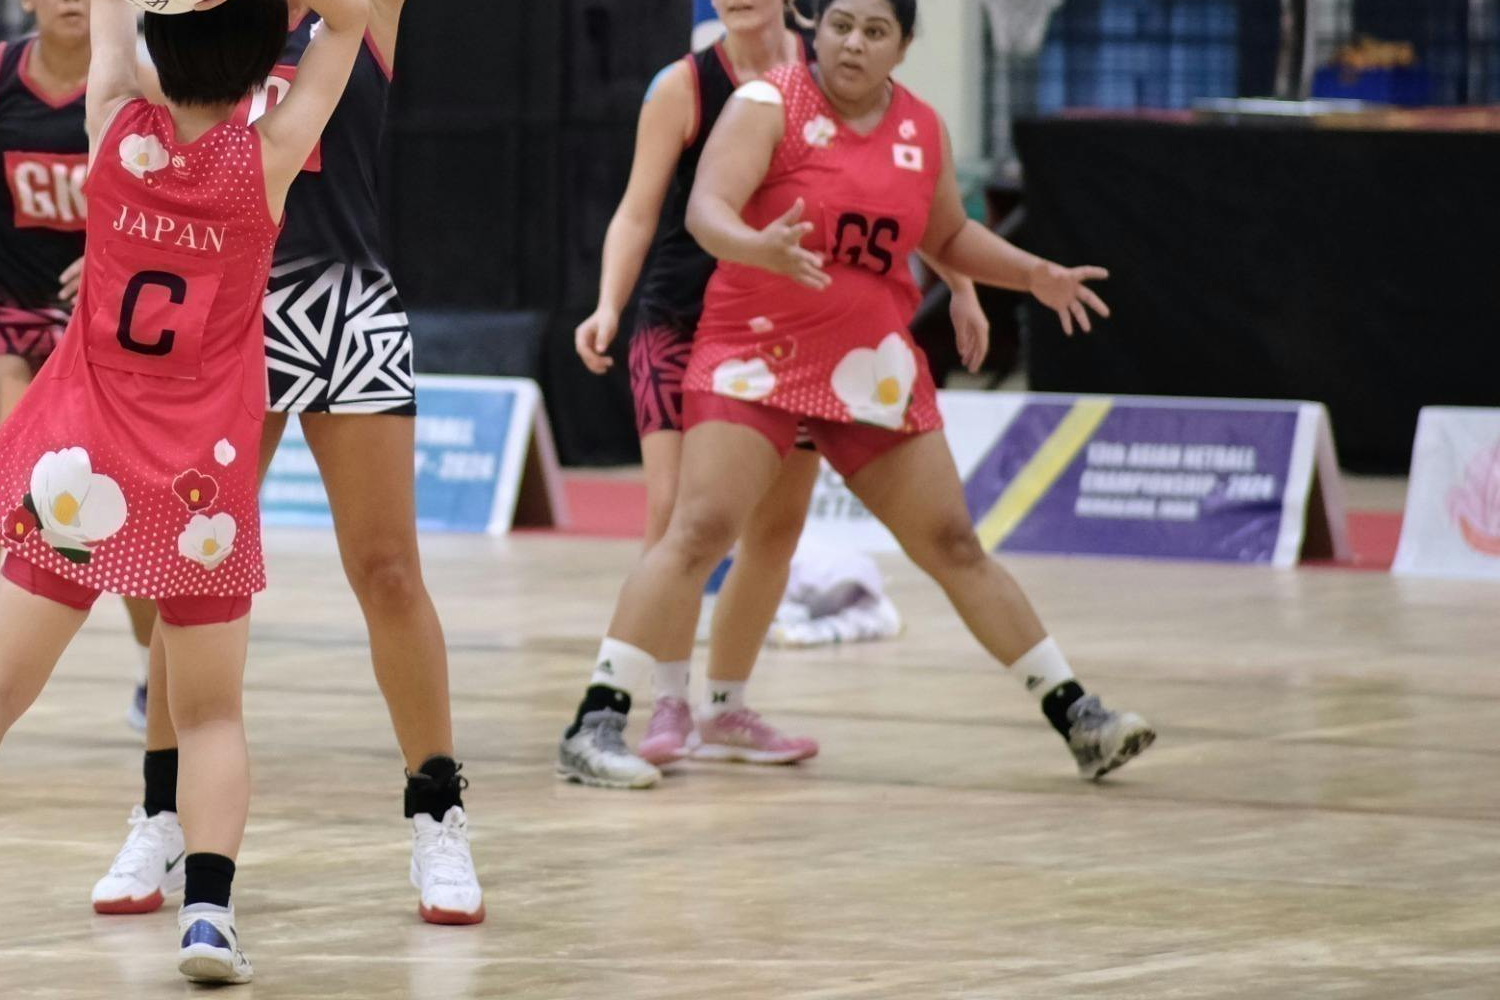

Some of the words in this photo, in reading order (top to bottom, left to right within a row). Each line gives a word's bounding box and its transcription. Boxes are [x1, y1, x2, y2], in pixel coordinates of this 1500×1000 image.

[15, 160, 87, 222] GK
[113, 204, 228, 253] JAPAN
[832, 212, 900, 276] GS
[116, 269, 188, 357] C
